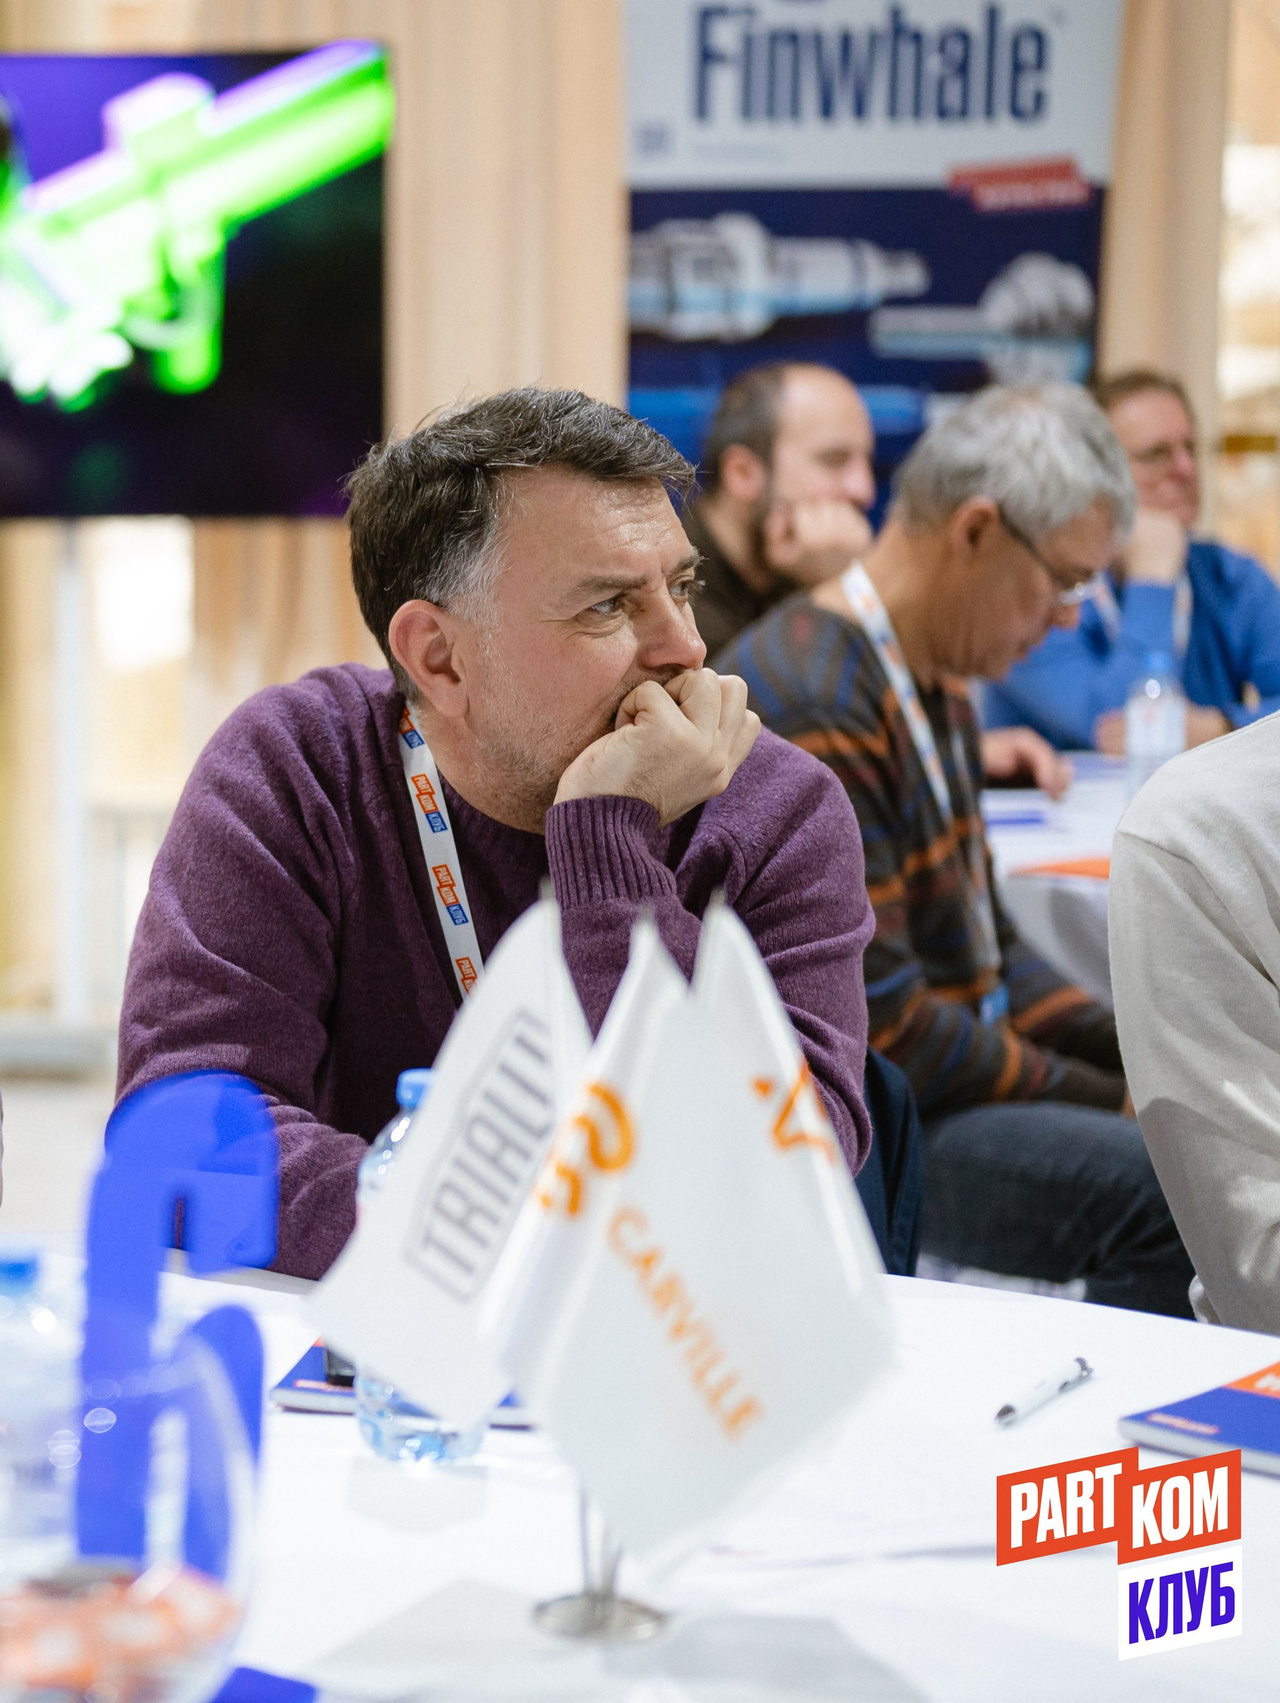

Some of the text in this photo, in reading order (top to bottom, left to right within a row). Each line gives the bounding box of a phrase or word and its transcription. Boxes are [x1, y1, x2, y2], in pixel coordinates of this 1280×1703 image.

[695, 3, 1051, 126] Finwhale
[414, 775, 432, 793] PART
[435, 867, 454, 885] PART
[604, 1203, 768, 1445] CARVILLE
